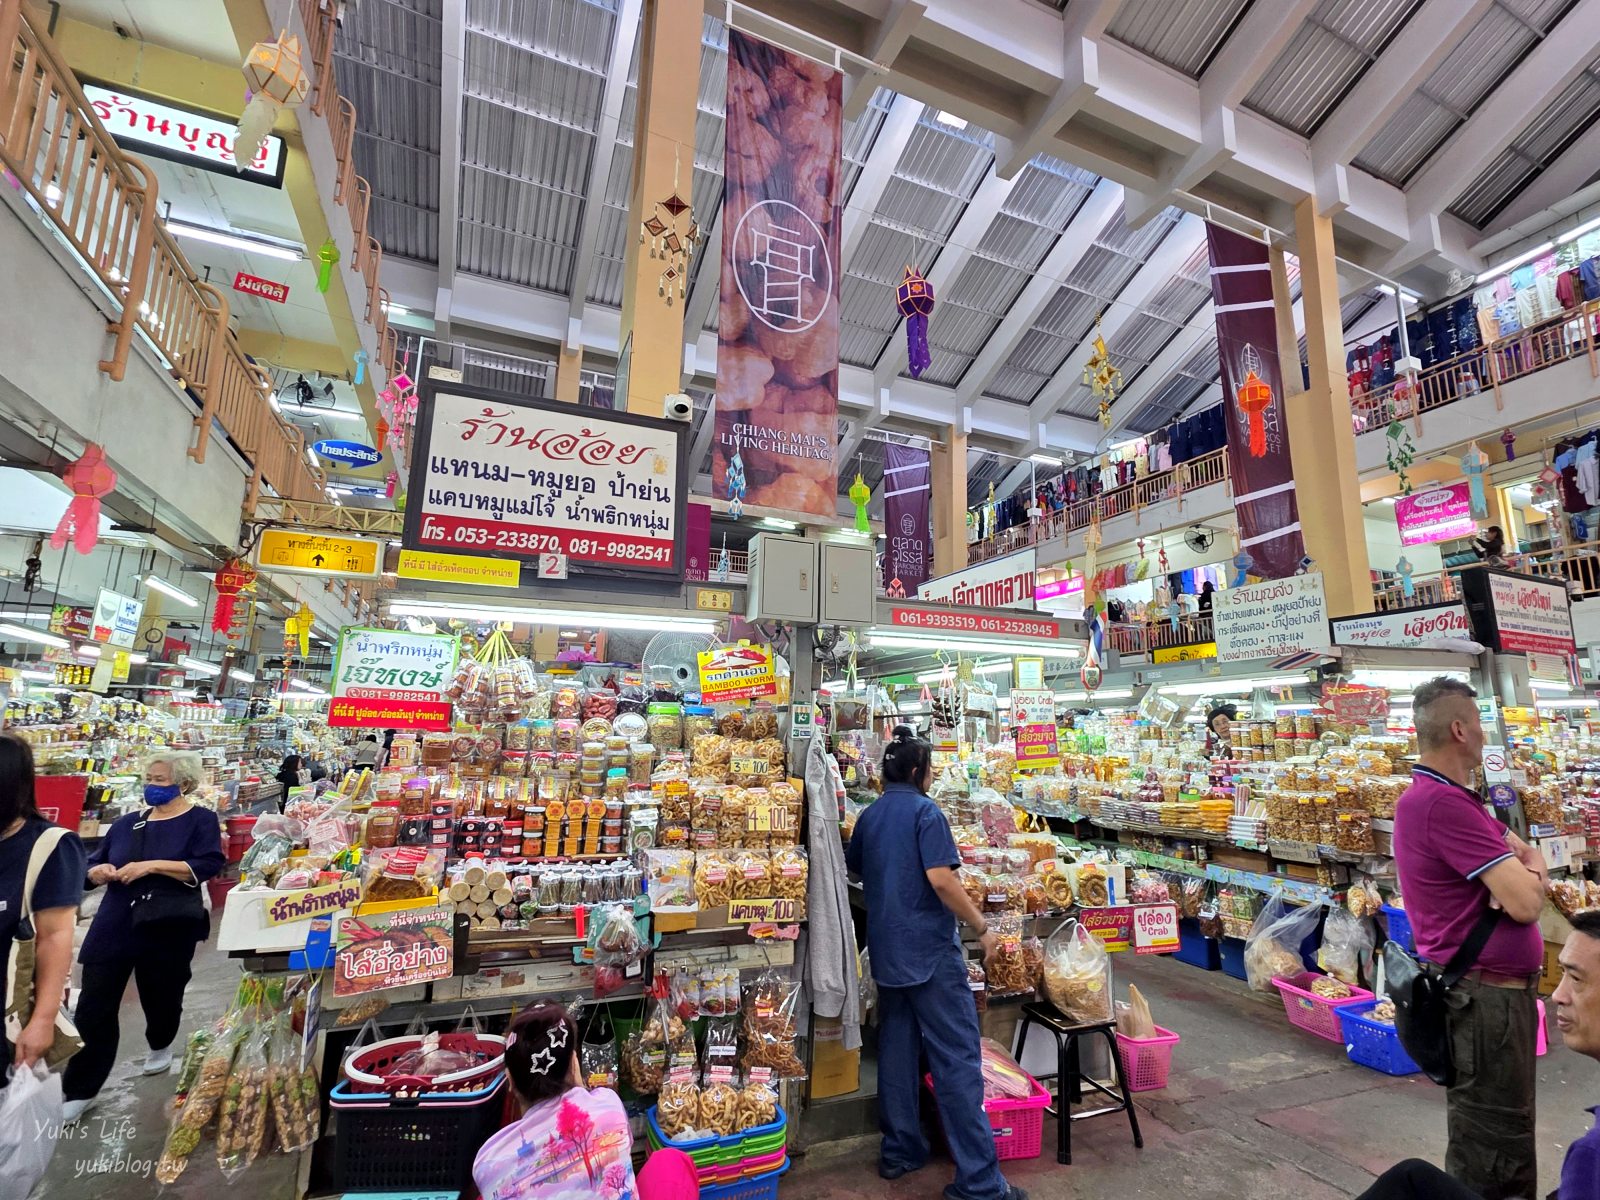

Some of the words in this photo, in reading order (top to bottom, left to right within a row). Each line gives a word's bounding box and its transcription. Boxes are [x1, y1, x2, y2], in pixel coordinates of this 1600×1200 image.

[460, 407, 657, 467] ร้านอ้อย
[732, 423, 787, 442] CHIANG
[790, 432, 827, 447] MAI'S
[721, 433, 768, 451] LIVING
[772, 442, 832, 462] HERITAG
[431, 455, 596, 499] แหนม-หมูยอ
[608, 471, 671, 504] ป้าย่น
[428, 488, 555, 521] แคบหมูแม่โจ้
[566, 495, 670, 537] น้ำพริกหนุ่ม
[288, 536, 331, 551] ทางขึ้นชั้น
[569, 537, 671, 563] 081-9982541
[545, 555, 560, 575] 2
[1232, 581, 1294, 605] ร้านบุญส่ง
[900, 612, 979, 630] 061-9393519,
[980, 618, 1053, 636] 061-2528945
[357, 633, 443, 662] น้ำพริกหนุ่ม
[702, 680, 741, 692] BAMBOO
[744, 675, 774, 686] WORM
[706, 666, 768, 681] รถด่วนอบ
[361, 688, 437, 702] 081-9982541
[416, 709, 444, 721] จำหน่าย
[733, 762, 742, 772] 3
[752, 760, 768, 774] 100
[748, 806, 758, 830] 4
[768, 807, 786, 830] 100
[269, 884, 361, 923] น้ำพริกหนุ่ม
[731, 904, 768, 922] แคบหมู
[772, 900, 795, 919] 100
[389, 911, 448, 927] ที่นี่จำหน่าย
[1082, 911, 1130, 927] ไส้อั่วย่าง
[1138, 909, 1172, 932] ปูอ่อง
[1148, 926, 1168, 936] Crab
[341, 939, 448, 978] ไส้อั่วย่าง
